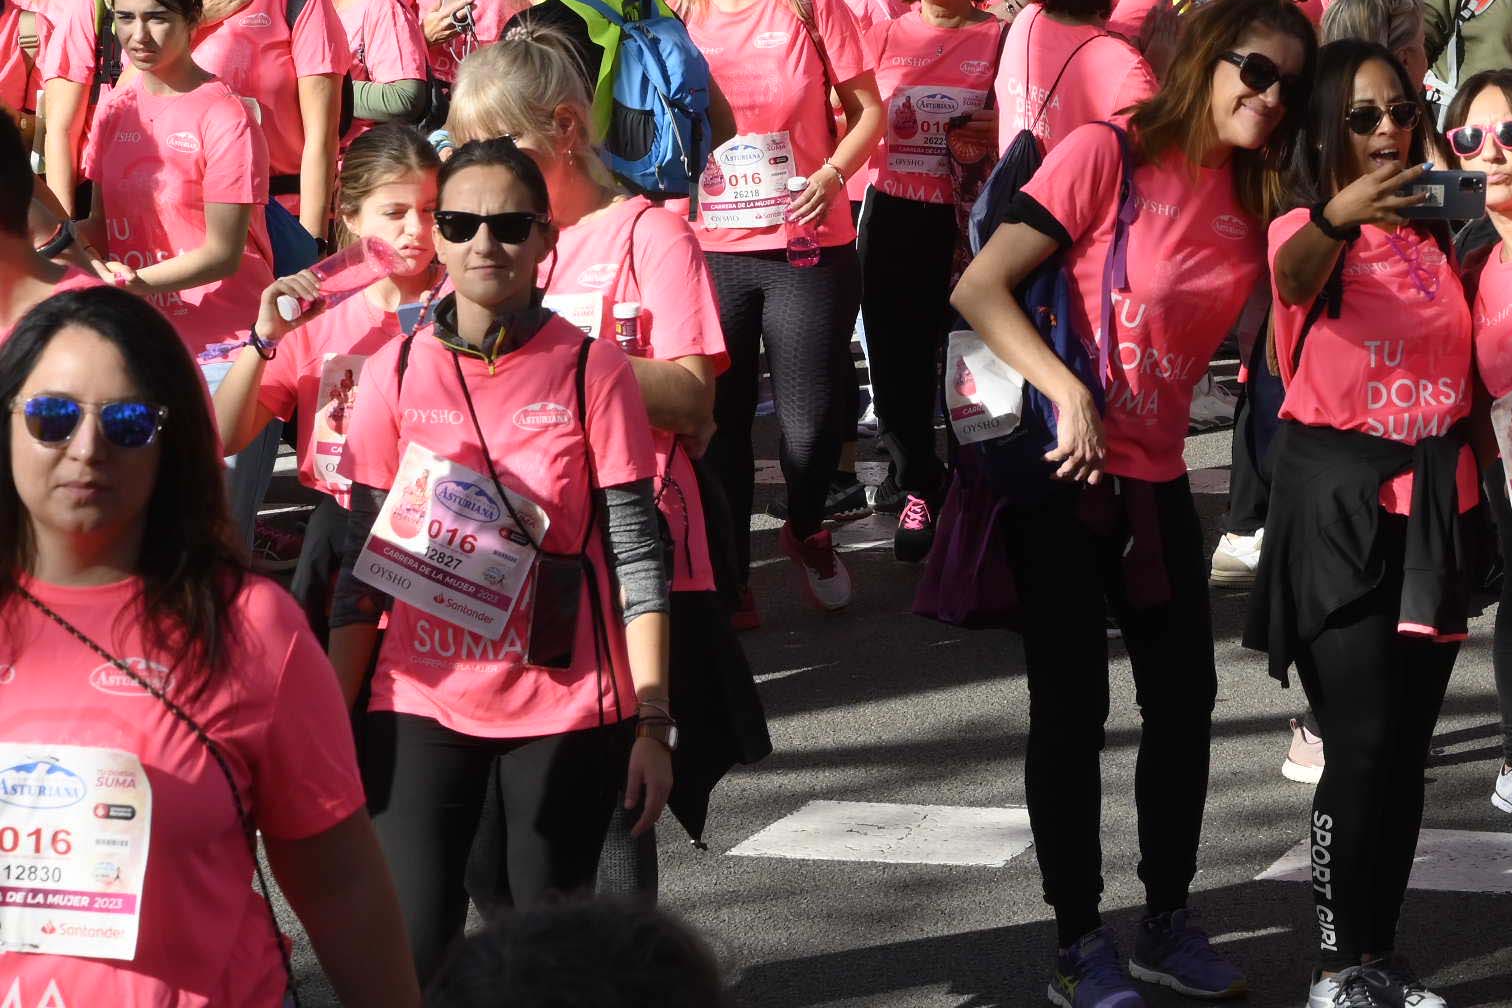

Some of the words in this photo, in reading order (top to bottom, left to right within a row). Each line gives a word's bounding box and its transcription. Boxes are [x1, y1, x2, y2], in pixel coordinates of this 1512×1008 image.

[723, 152, 761, 162] ASTURIANA
[728, 171, 763, 187] 016
[710, 203, 737, 211] CARRERA
[733, 189, 760, 199] 26218
[1114, 341, 1195, 381] ORSAL
[1364, 340, 1405, 369] TU
[404, 408, 464, 425] OYSHO
[517, 409, 570, 425] ASTURIANA
[439, 486, 497, 521] ASTURIANA
[427, 519, 479, 555] 016
[382, 546, 420, 571] CARRERA
[420, 564, 432, 576] DE
[432, 569, 445, 582] LA
[445, 574, 477, 594] MUJER
[424, 544, 463, 571] 12827
[369, 562, 413, 590] OYSHO
[445, 596, 496, 625] Santander
[414, 619, 523, 661] SUMA
[96, 777, 137, 790] SUMA
[0, 826, 73, 856] 016
[1311, 810, 1333, 901] SPORT
[3, 864, 62, 883] 12830
[7, 891, 25, 904] DE
[26, 892, 45, 905] LA
[47, 894, 90, 908] MUJER
[94, 895, 123, 910] 2023
[59, 922, 127, 938] Santander
[1316, 904, 1338, 952] GIRL
